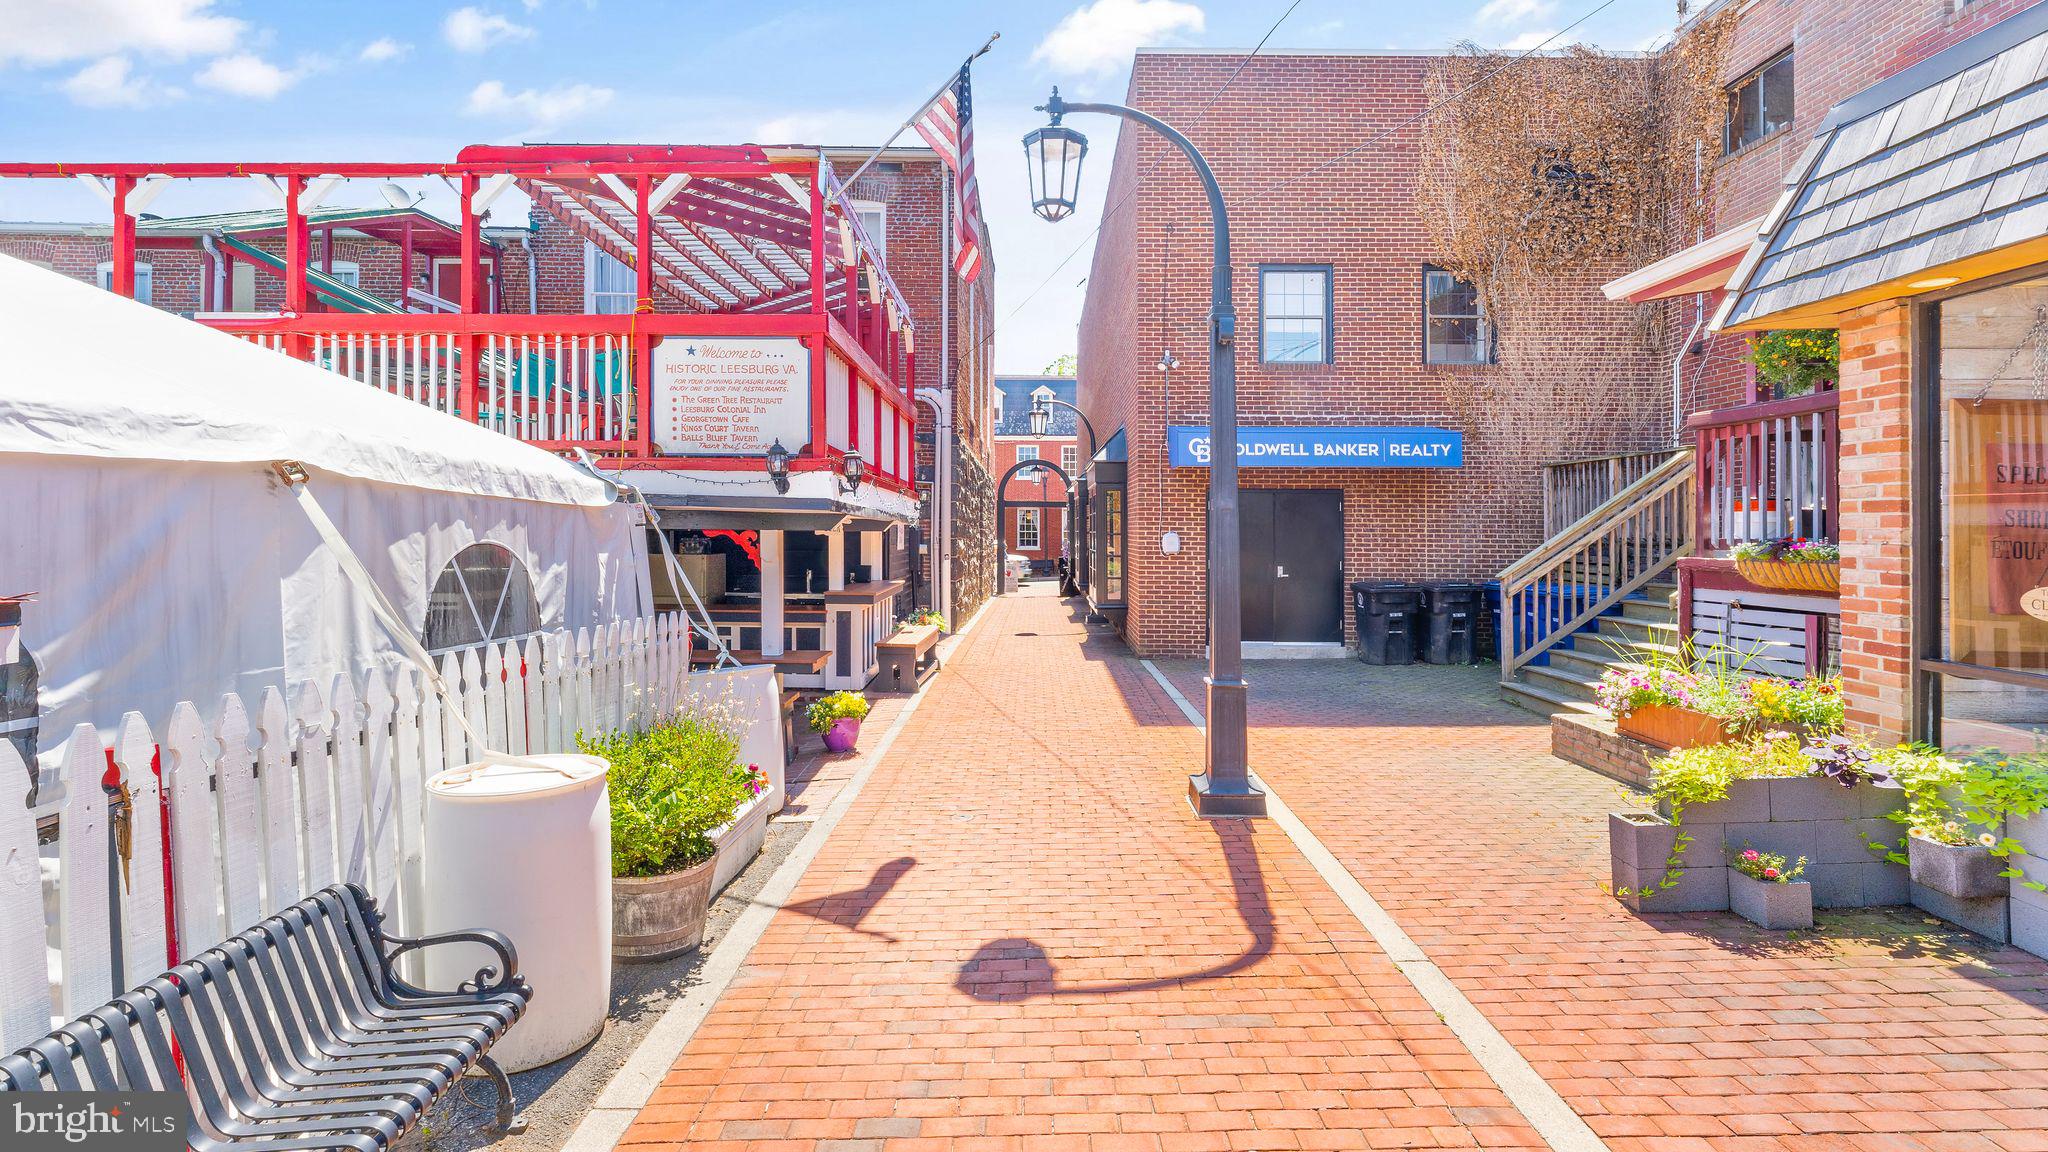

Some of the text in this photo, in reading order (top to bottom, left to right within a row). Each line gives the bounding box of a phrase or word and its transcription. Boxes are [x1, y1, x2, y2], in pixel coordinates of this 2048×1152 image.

[699, 344, 748, 359] Welcome
[750, 349, 763, 359] to
[665, 363, 799, 375] HISTORIC LEESBURG VA.
[1236, 443, 1452, 457] OLDWELL BANKER REALTY
